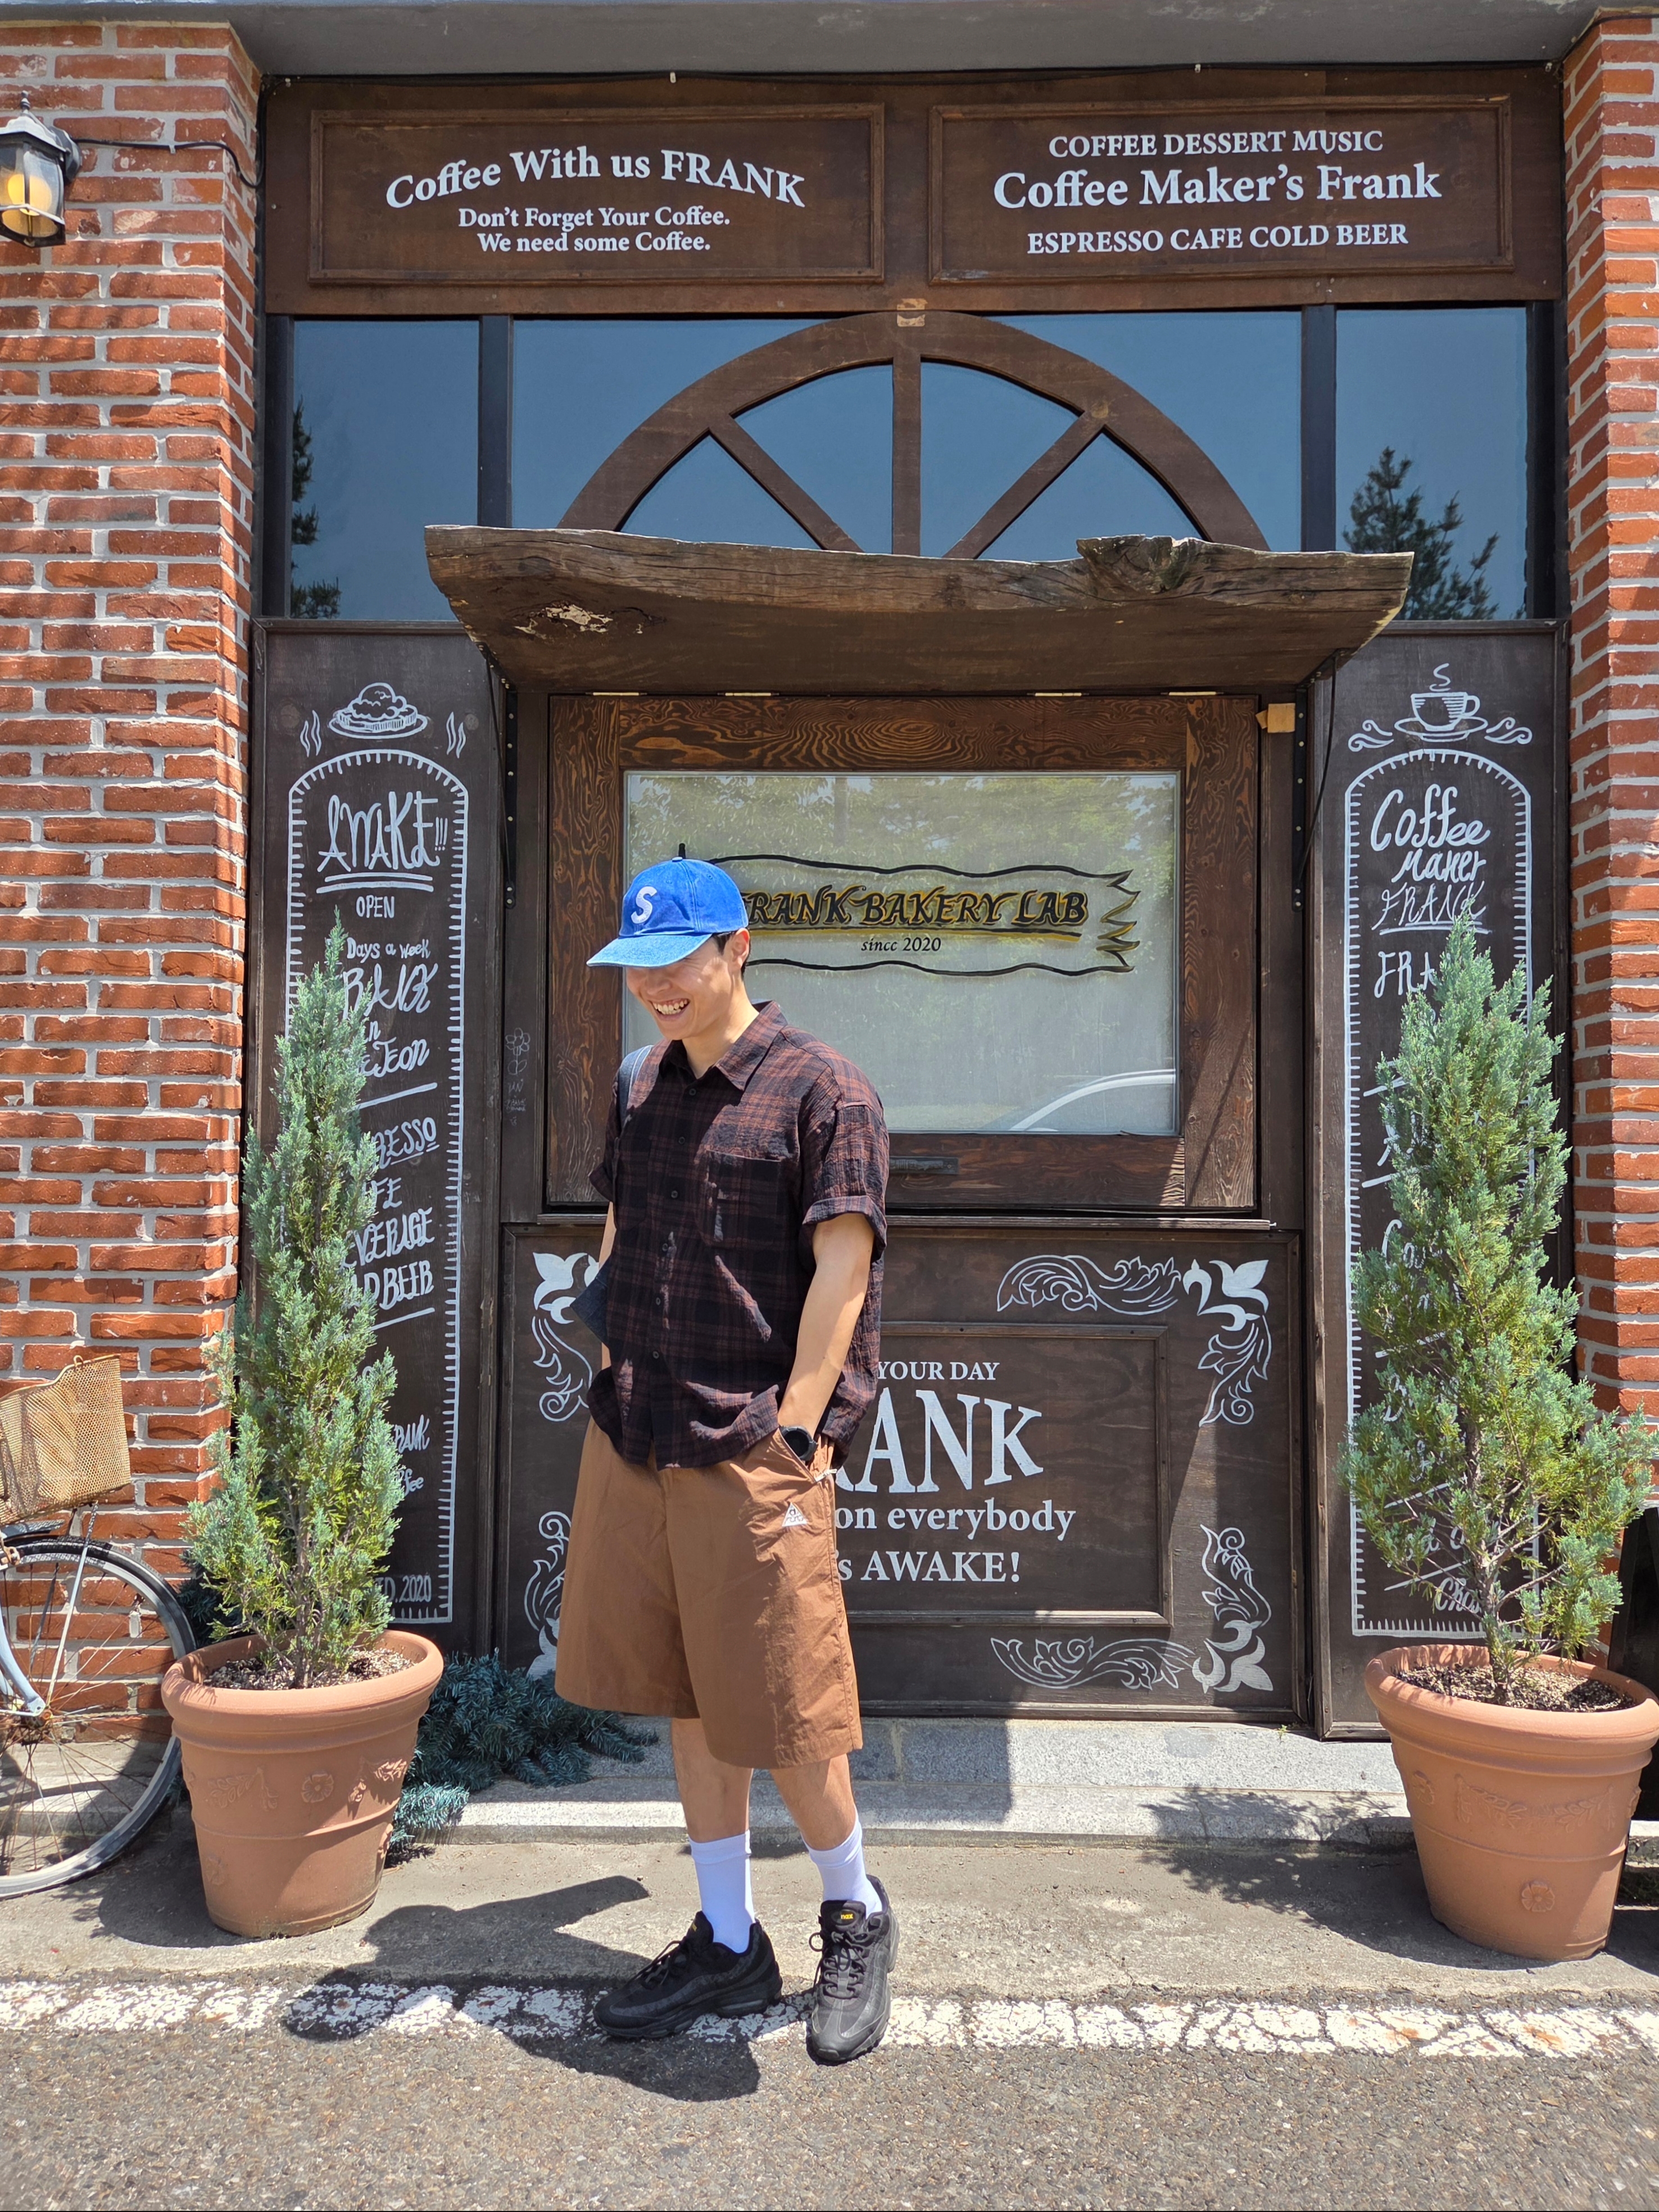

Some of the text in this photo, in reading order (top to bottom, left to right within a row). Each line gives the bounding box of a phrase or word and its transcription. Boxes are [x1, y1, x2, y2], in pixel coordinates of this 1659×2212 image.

[1049, 130, 1383, 157] COFFEE DESSERT MUSIC
[387, 146, 805, 208] Coffee With us FRANK
[994, 162, 1442, 208] Coffee Maker's Frank
[459, 206, 730, 231] Don't Forget Your Coffee.
[477, 230, 710, 252] We need some Coffee.
[1027, 224, 1409, 254] ESPRESSO CAFE COLD BEER
[1371, 783, 1491, 851] Coffee
[356, 895, 395, 918] OPEN
[631, 886, 658, 924] S
[849, 886, 1020, 926] BAKERY
[1012, 890, 1089, 926] LAB
[1371, 880, 1487, 931] FRANK
[347, 937, 380, 963] Days
[386, 943, 397, 955] a
[903, 936, 941, 951] 2020
[339, 963, 439, 1020] RANK
[371, 1117, 437, 1170] RESSO
[379, 1259, 435, 1310] BEER
[878, 1362, 1000, 1380] YOUR DAY
[835, 1386, 1044, 1494] ANK
[835, 1507, 877, 1530] on
[888, 1497, 1076, 1541] everybody
[860, 1551, 1021, 1582] AWAKE!
